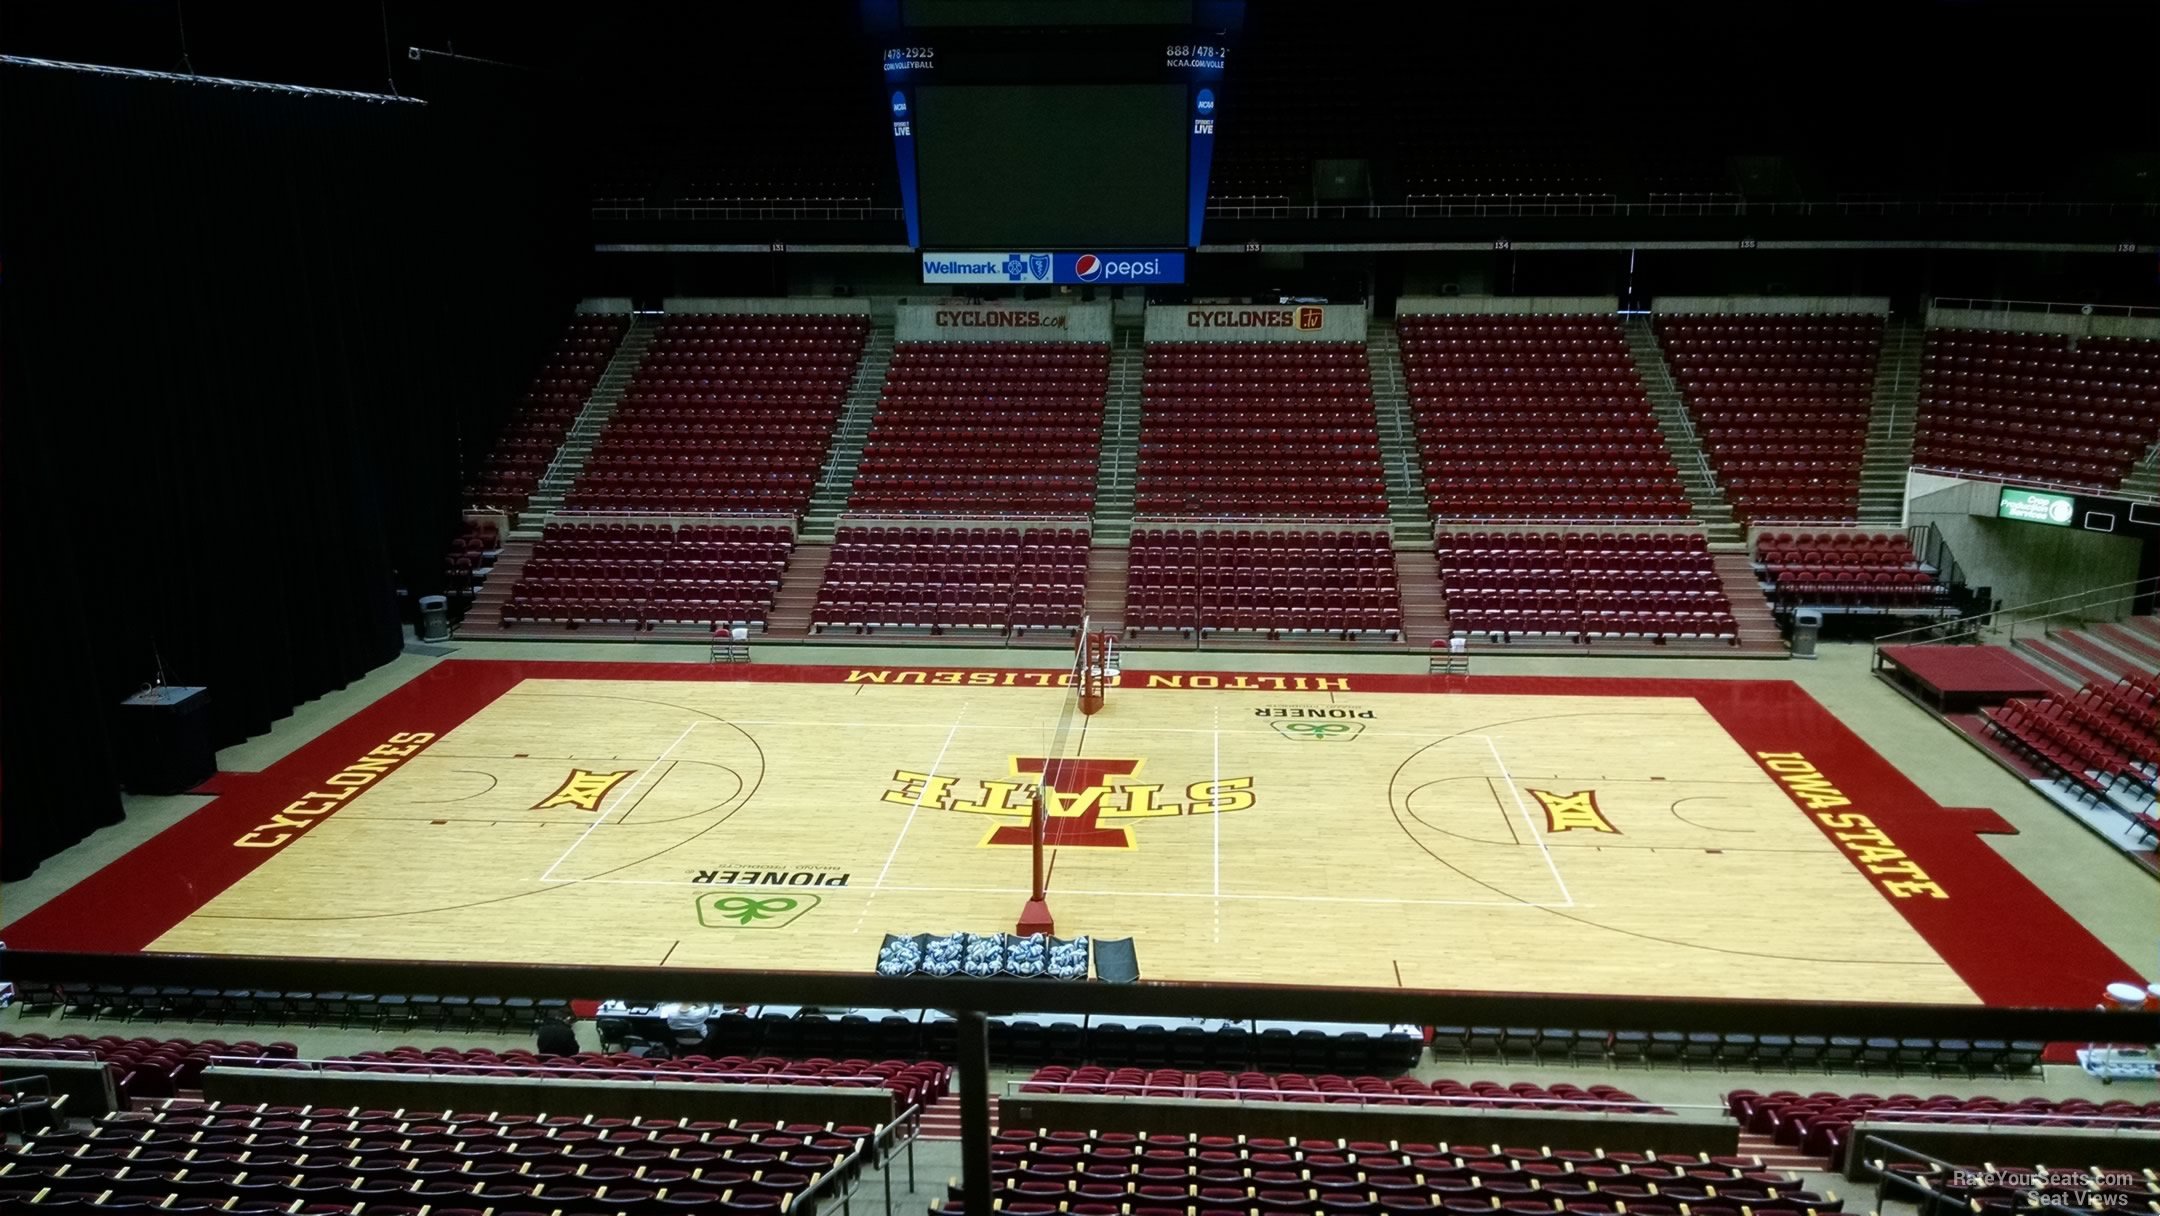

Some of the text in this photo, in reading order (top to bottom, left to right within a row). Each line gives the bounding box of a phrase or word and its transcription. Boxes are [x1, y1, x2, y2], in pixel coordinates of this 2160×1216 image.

[893, 103, 907, 111] NCAA
[1197, 101, 1214, 109] NCAA
[894, 126, 911, 136] LIVE
[1194, 124, 1214, 134] LIVE
[924, 260, 998, 275] Wellmark
[1105, 258, 1159, 278] pepsi
[1187, 311, 1294, 328] CYCLONES
[1146, 674, 1351, 690] HILTON
[1255, 707, 1377, 719] PIONEER
[233, 731, 436, 849] CYCLONES
[880, 769, 1257, 819] STATE
[1756, 751, 1950, 900] IOWA STATE
[691, 870, 851, 887] PIONEER
